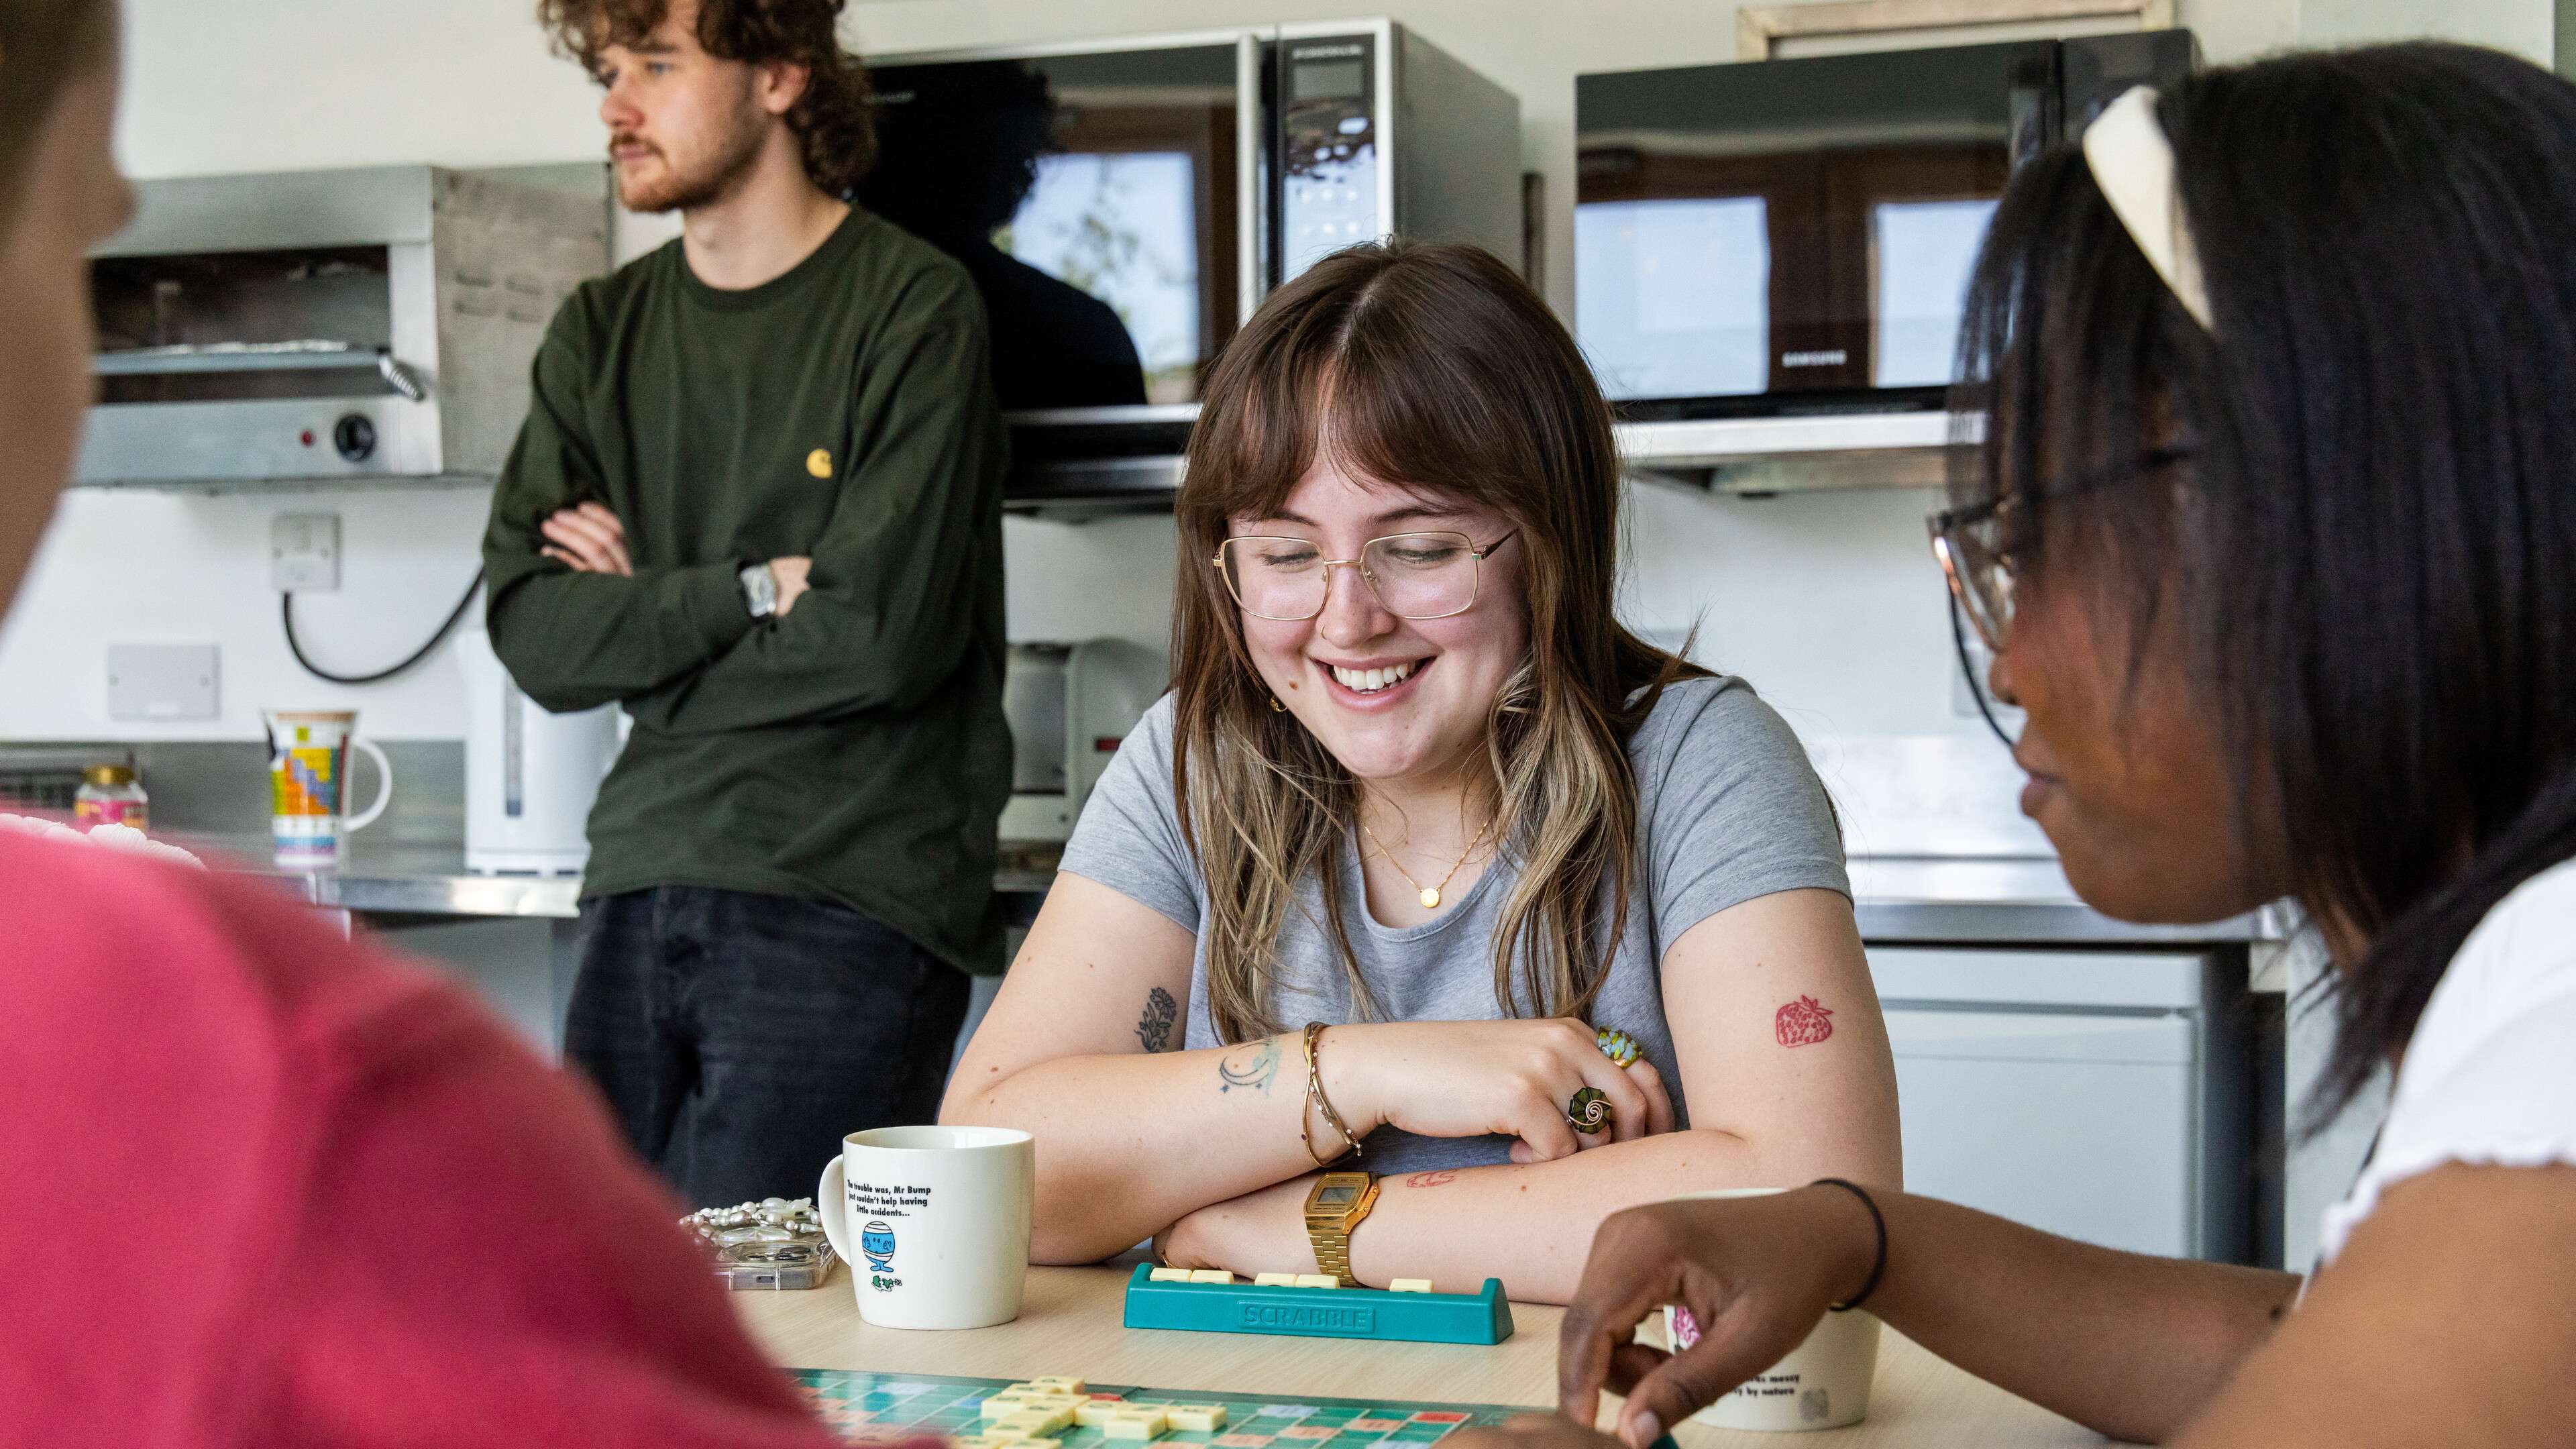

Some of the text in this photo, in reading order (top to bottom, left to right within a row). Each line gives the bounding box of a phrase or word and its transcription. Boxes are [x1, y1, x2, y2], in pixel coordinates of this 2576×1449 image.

[854, 1183, 873, 1193] trouble
[875, 1187, 892, 1195] was,
[894, 1186, 905, 1194] Mr
[908, 1186, 931, 1195] Bump
[857, 1195, 879, 1205] couldn't
[881, 1197, 897, 1208] help
[900, 1197, 928, 1207] having
[857, 1204, 910, 1216] little accidents...
[1244, 1305, 1367, 1330] SCRABBLE
